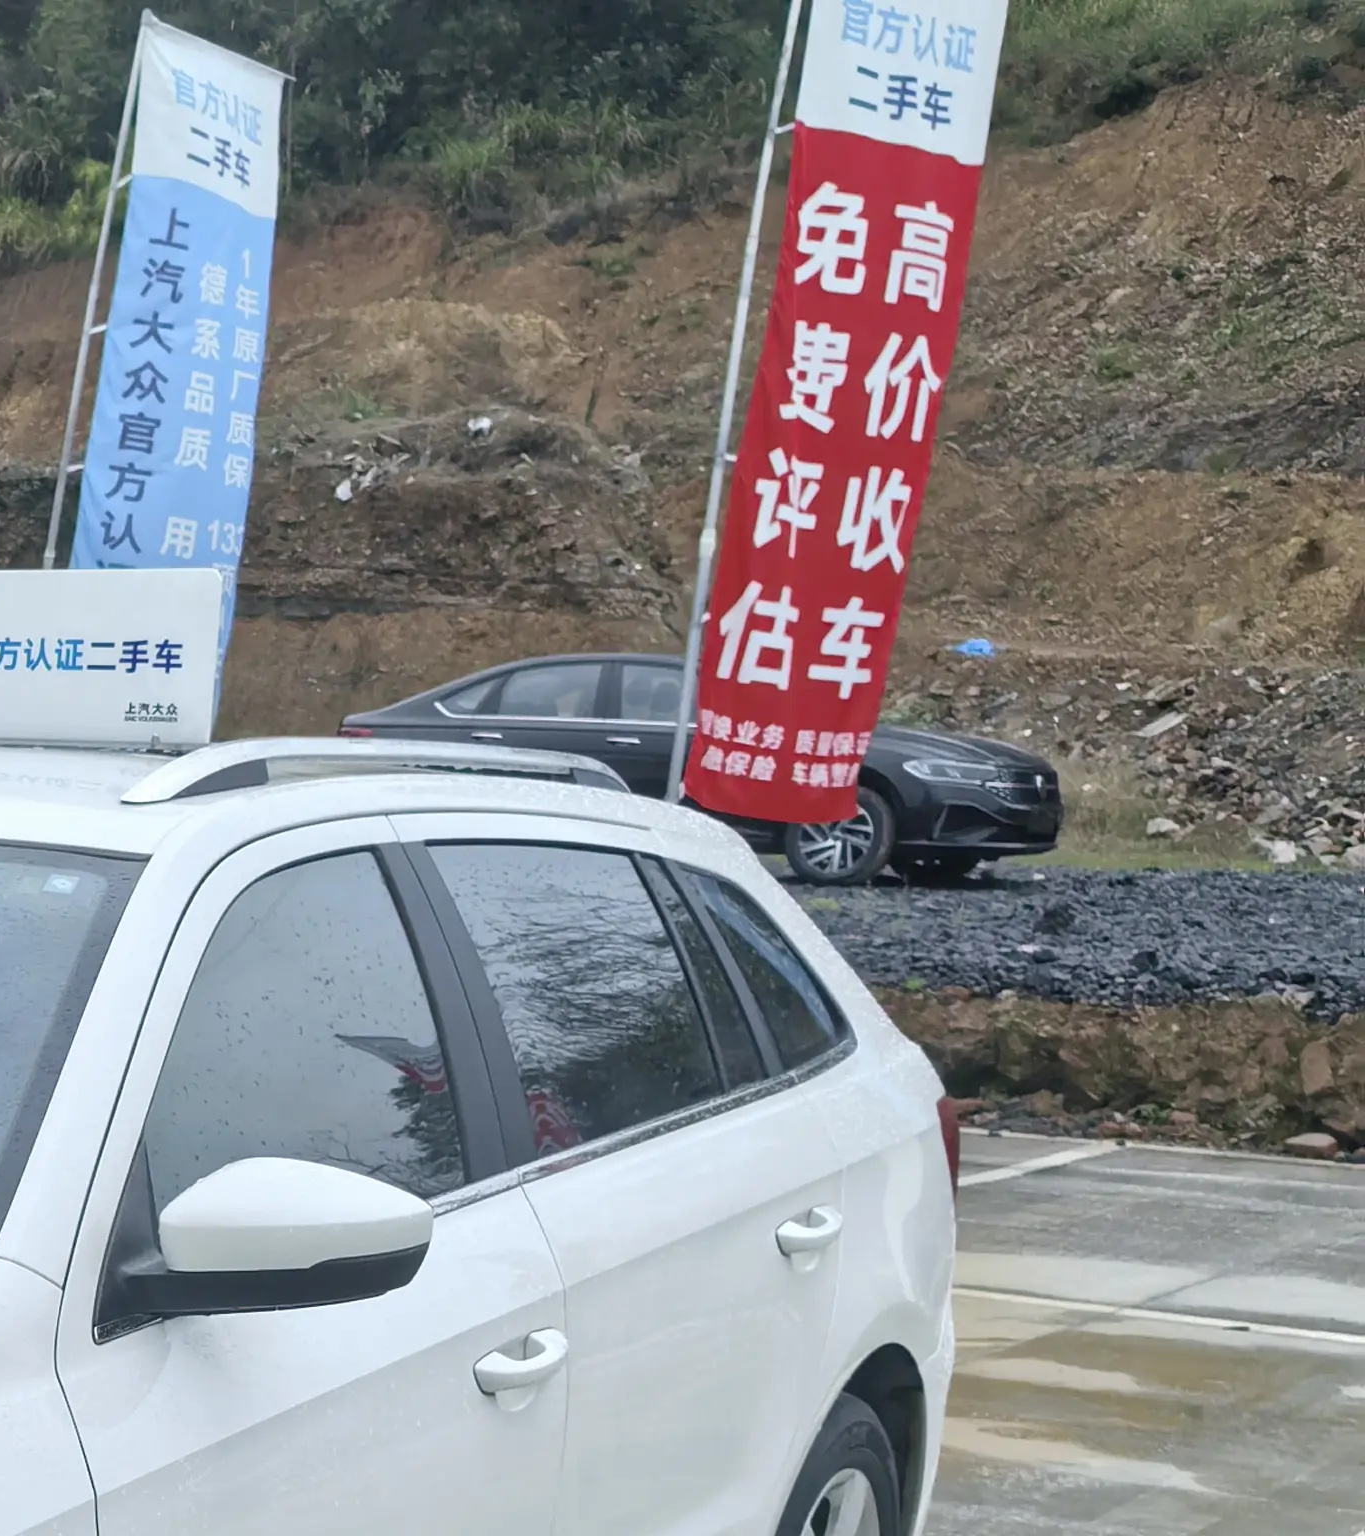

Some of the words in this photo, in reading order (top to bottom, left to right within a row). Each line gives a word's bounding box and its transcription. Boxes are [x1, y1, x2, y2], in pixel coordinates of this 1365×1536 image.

[841, 0, 977, 74] 官方认证
[171, 67, 263, 147] 官方认证
[848, 65, 953, 131] 二手车
[186, 126, 251, 188] 二手车
[96, 208, 191, 568] 上汽大众官方认
[716, 180, 869, 691] 免费评估
[807, 200, 955, 700] 高价收车
